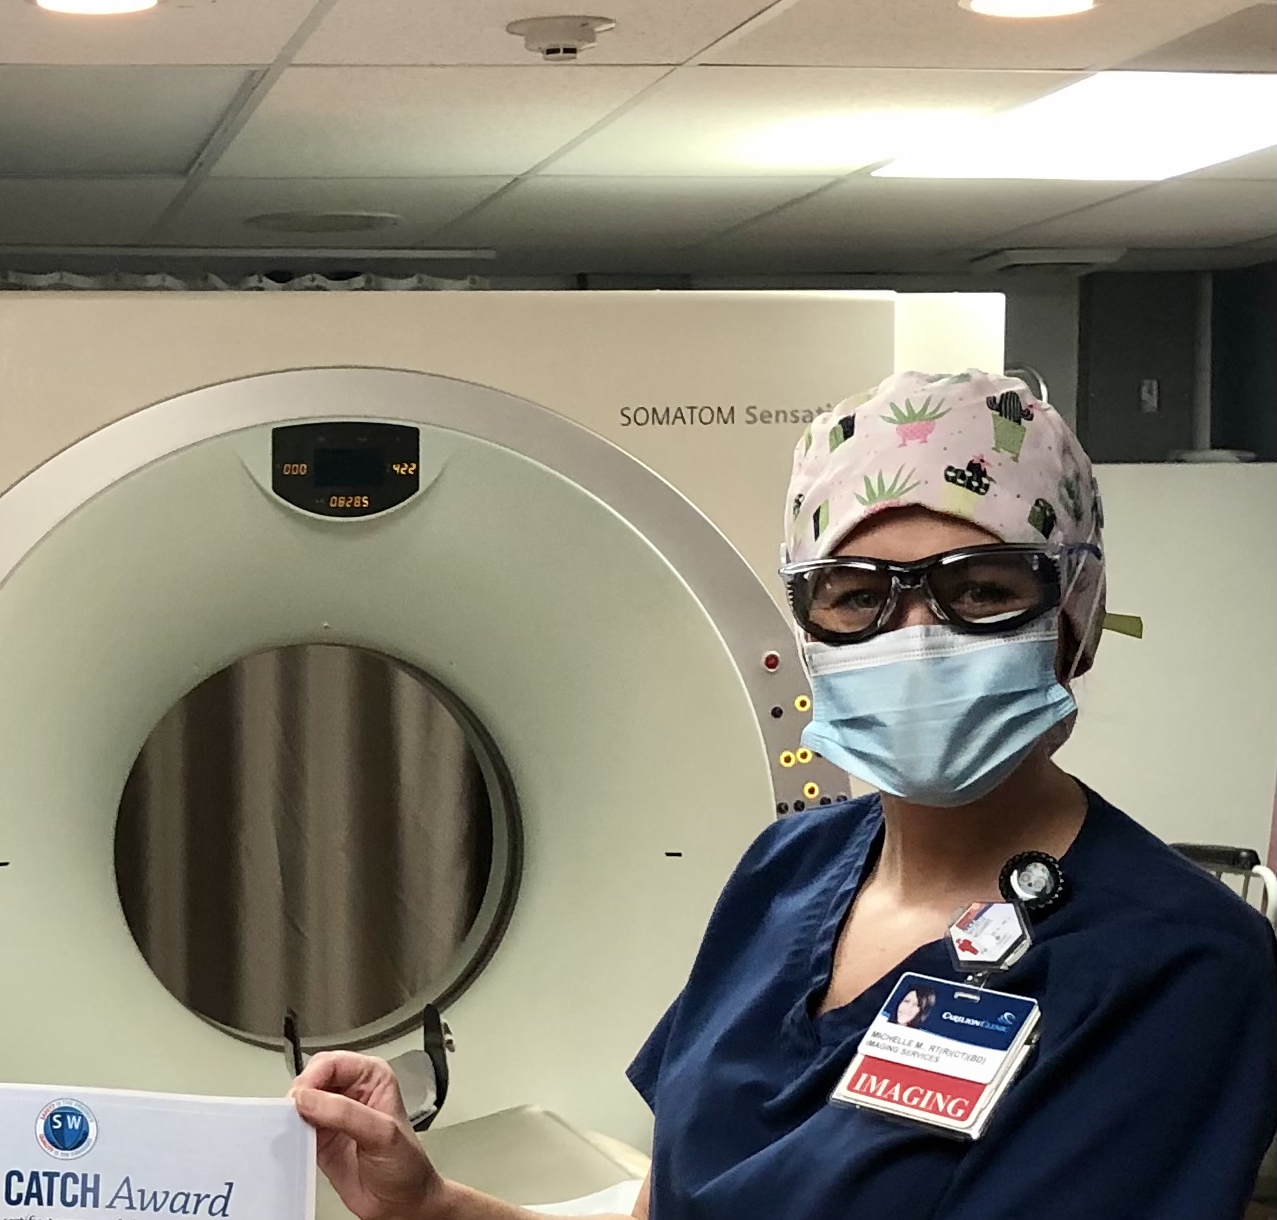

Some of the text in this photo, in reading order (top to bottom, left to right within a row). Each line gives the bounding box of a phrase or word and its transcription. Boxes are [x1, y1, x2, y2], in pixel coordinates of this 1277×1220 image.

[620, 405, 735, 426] SOMATOM
[393, 463, 416, 475] 422
[871, 1031, 914, 1047] MICHELLE
[866, 1040, 940, 1063] IMAGING SERVICES
[853, 1073, 969, 1118] IMAGING
[4, 1169, 100, 1209] CATCH
[105, 1175, 234, 1217] Award
